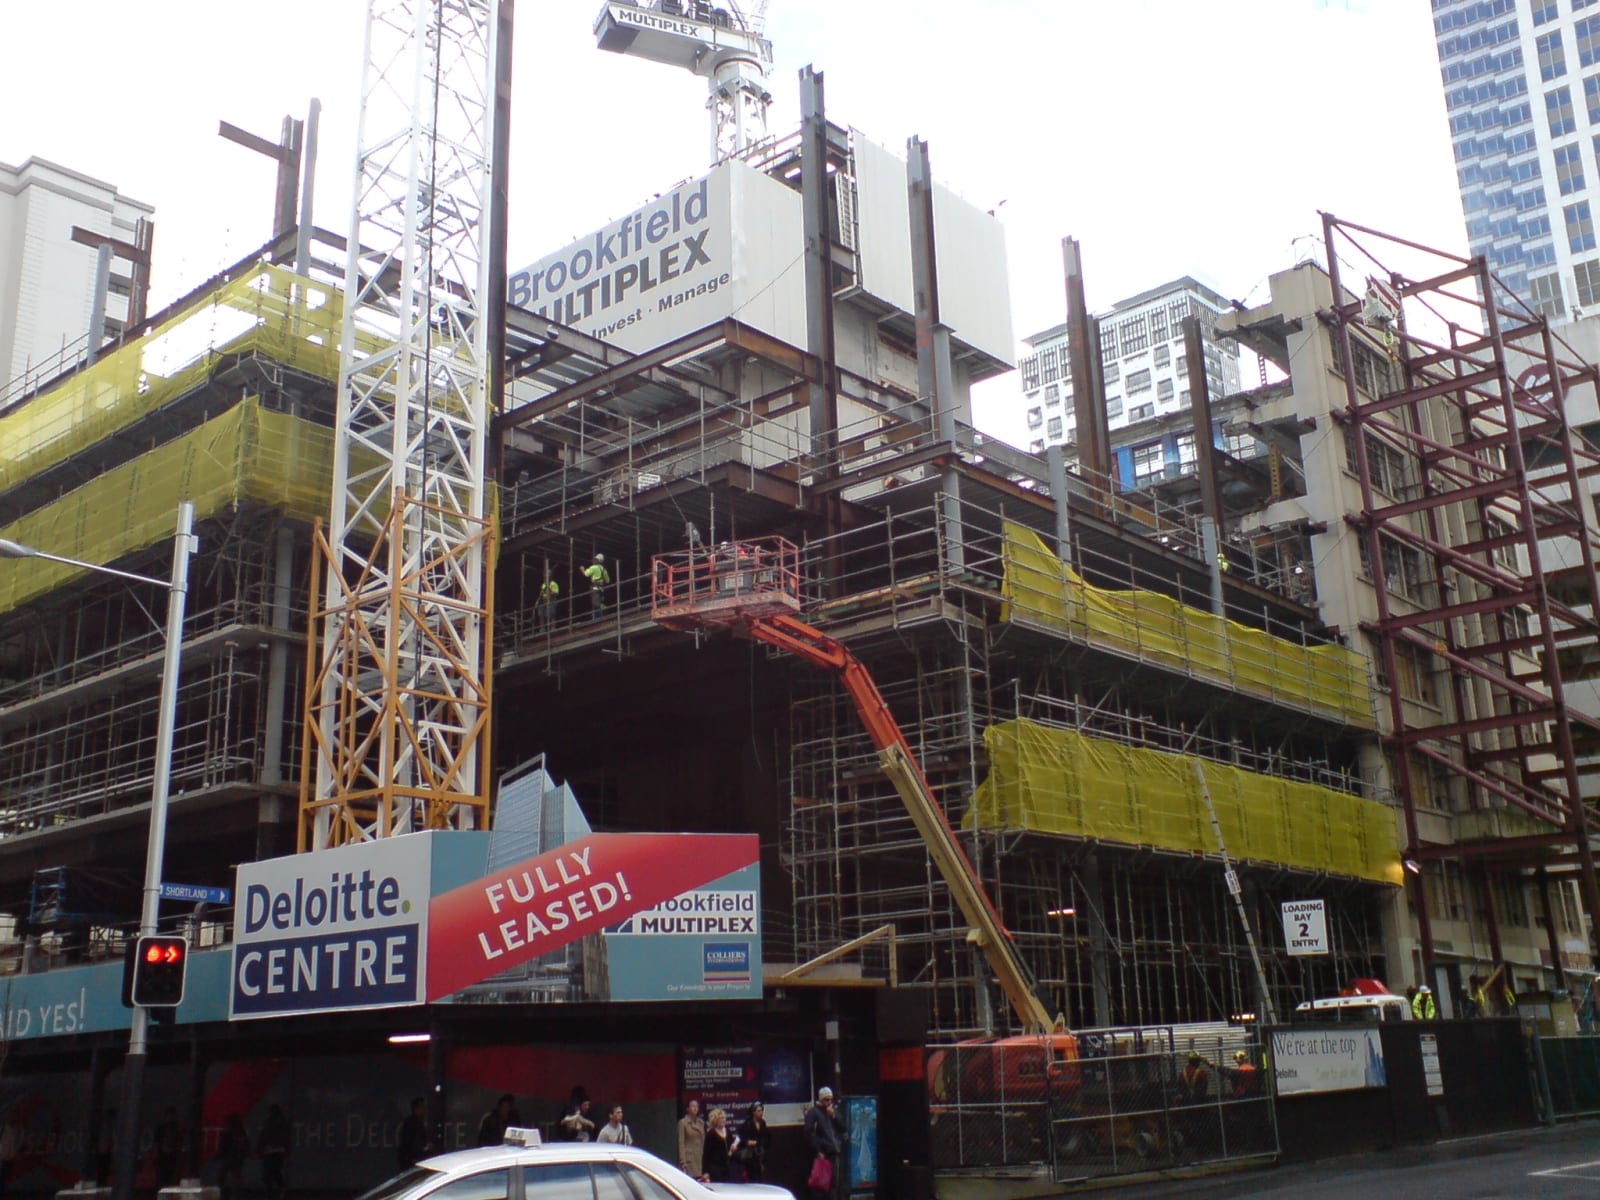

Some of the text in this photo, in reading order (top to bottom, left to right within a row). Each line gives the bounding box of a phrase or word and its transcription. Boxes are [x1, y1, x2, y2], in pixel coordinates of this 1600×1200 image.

[619, 10, 699, 37] MULTIPLEX
[508, 179, 709, 307] Brookfield
[539, 228, 712, 326] ULTIPLEX
[658, 271, 730, 313] Manage
[166, 886, 208, 900] SHORTLAND
[483, 846, 593, 914] FULLY
[477, 871, 633, 961] LEASED!
[648, 893, 755, 913] rookfield
[1283, 903, 1323, 913] LOADING
[640, 915, 755, 934] MULTIPLEX
[1294, 913, 1312, 922] BAY
[1298, 922, 1309, 937] 2
[1291, 938, 1320, 948] ENTRY
[238, 935, 408, 997] CENTRE
[39, 987, 86, 1035] YES!
[1273, 1032, 1357, 1060] We're at the top
[705, 1058, 731, 1067] Salon
